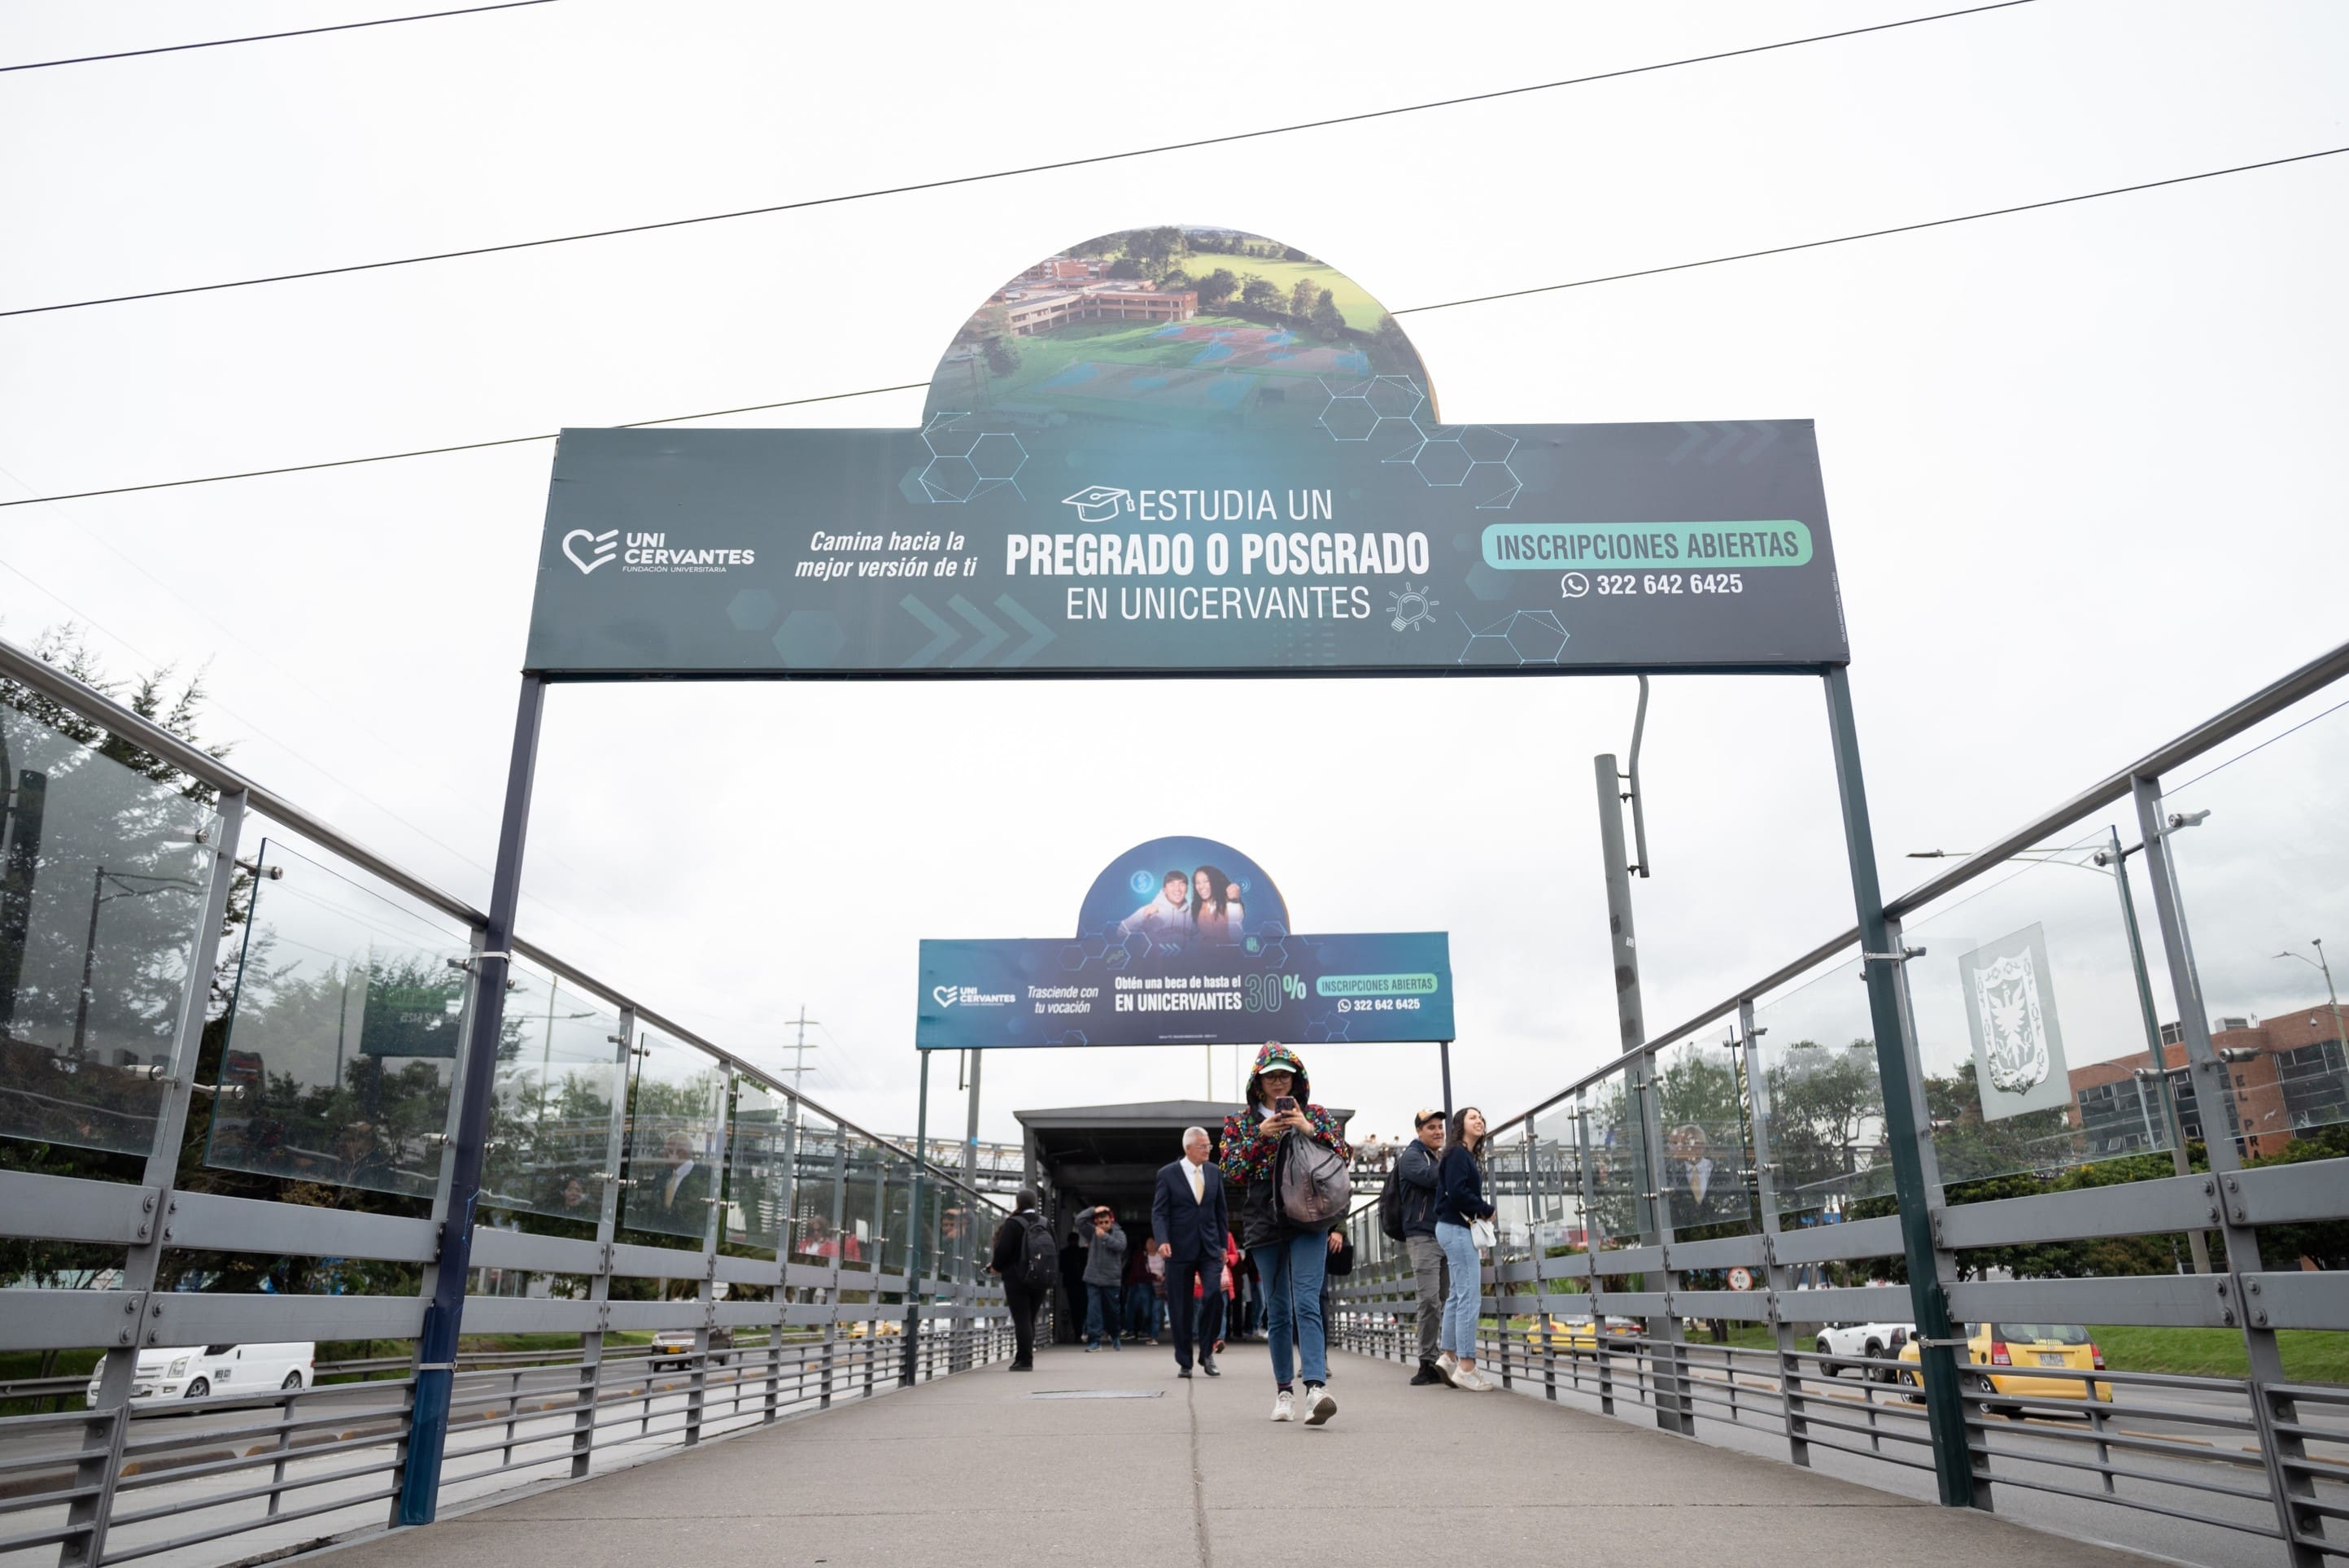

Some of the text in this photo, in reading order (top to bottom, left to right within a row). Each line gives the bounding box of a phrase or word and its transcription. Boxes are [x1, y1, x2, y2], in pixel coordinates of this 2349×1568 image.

[1141, 490, 1331, 521] ESTUDIA UN
[627, 533, 665, 547] UNI
[811, 531, 964, 551] Camina hacia la
[1497, 531, 1798, 560] INSCRIPCIONES ABIERTAS
[625, 549, 754, 564] CERVANTES
[1006, 532, 1429, 575] PREGRADO O POSGRADO
[795, 557, 977, 581] mejor versión de ti
[1597, 574, 1742, 594] 322 642 6425
[1068, 586, 1370, 619] EN UNICERVANTES
[1115, 976, 1241, 989] Obtén una beca de hasta el
[1322, 978, 1432, 992] INSCRIPCIONES ABIERTAS
[960, 988, 978, 996] UNI
[960, 994, 1015, 1002] CERVANTES
[1028, 986, 1098, 998] Trasciende con
[1246, 974, 1307, 1011] 30%
[1035, 1001, 1090, 1013] tu vocación
[1116, 993, 1242, 1011] EN UNICERVANTES
[1354, 998, 1420, 1011] 322 642 6425
